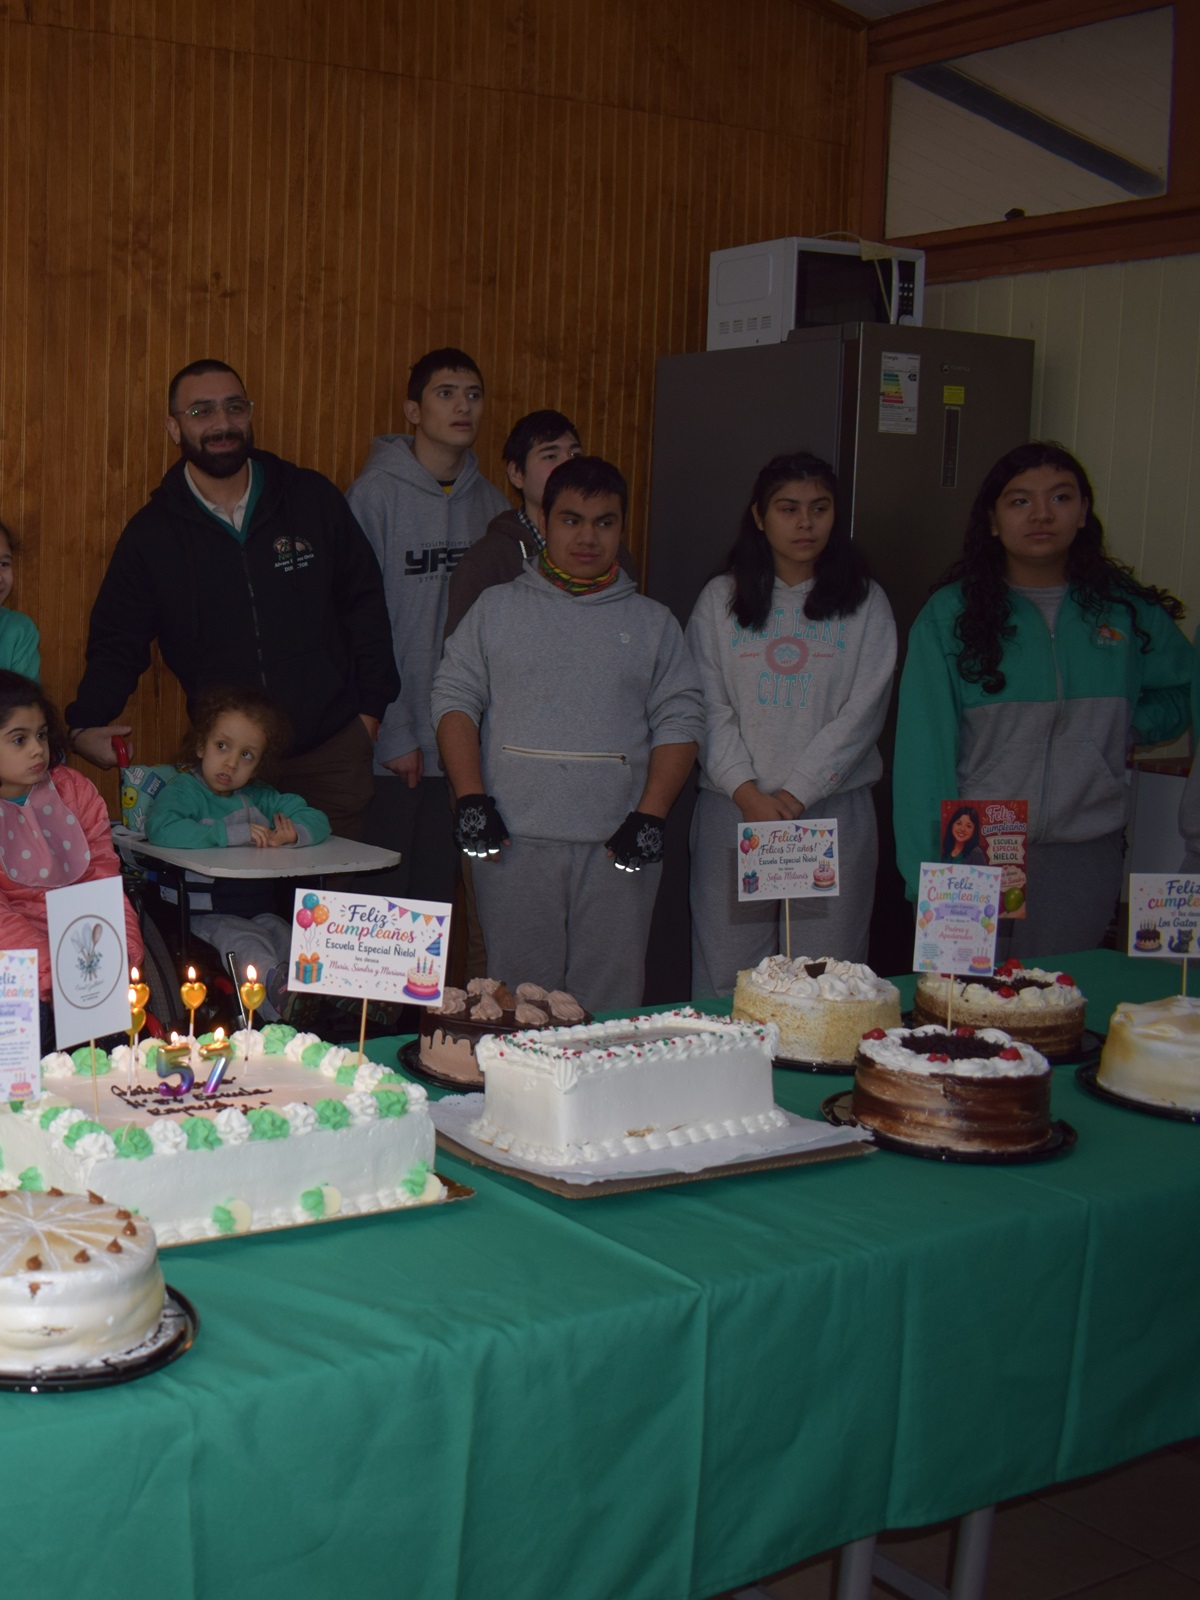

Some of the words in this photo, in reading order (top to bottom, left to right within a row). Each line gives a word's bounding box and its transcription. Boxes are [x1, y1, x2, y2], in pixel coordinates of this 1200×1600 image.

[757, 671, 814, 709] CITY
[985, 804, 1017, 824] Feliz
[981, 821, 1027, 836] cumpleaños
[768, 829, 803, 844] ¡Felices
[786, 843, 796, 853] 57
[993, 850, 1018, 860] ÑIELOL
[759, 857, 778, 866] Escuela
[779, 855, 801, 866] Especial
[947, 876, 974, 890] Feliz
[927, 886, 991, 904] Cumpleaños
[348, 904, 389, 928] Feliz
[1158, 917, 1170, 928] Los
[1173, 917, 1197, 928] Gatos
[327, 921, 417, 944] cumpleaños
[325, 938, 355, 951] Escuela
[358, 941, 391, 956] Especial
[393, 943, 416, 958] Ñielol
[351, 963, 374, 974] Sandra
[156, 1041, 234, 1097] 57
